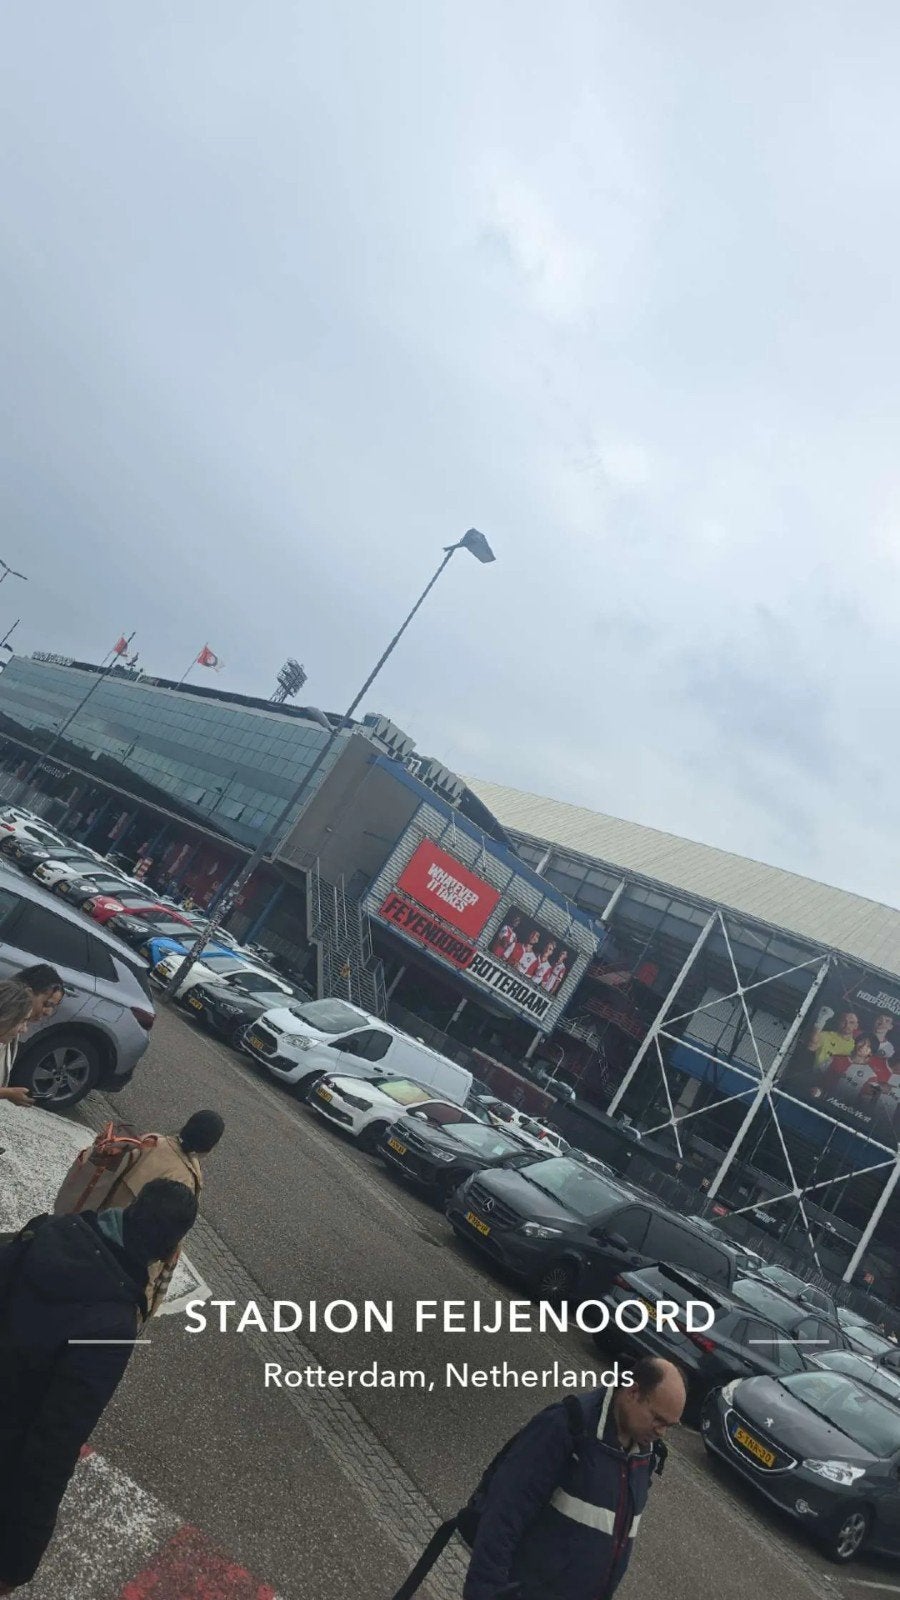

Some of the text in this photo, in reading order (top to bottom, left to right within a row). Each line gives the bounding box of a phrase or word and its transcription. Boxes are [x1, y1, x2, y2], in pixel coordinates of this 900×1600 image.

[427, 863, 480, 906] WHATEVER
[436, 886, 467, 913] TAKES
[384, 897, 550, 1017] FEYENOORD ROTTERDAM
